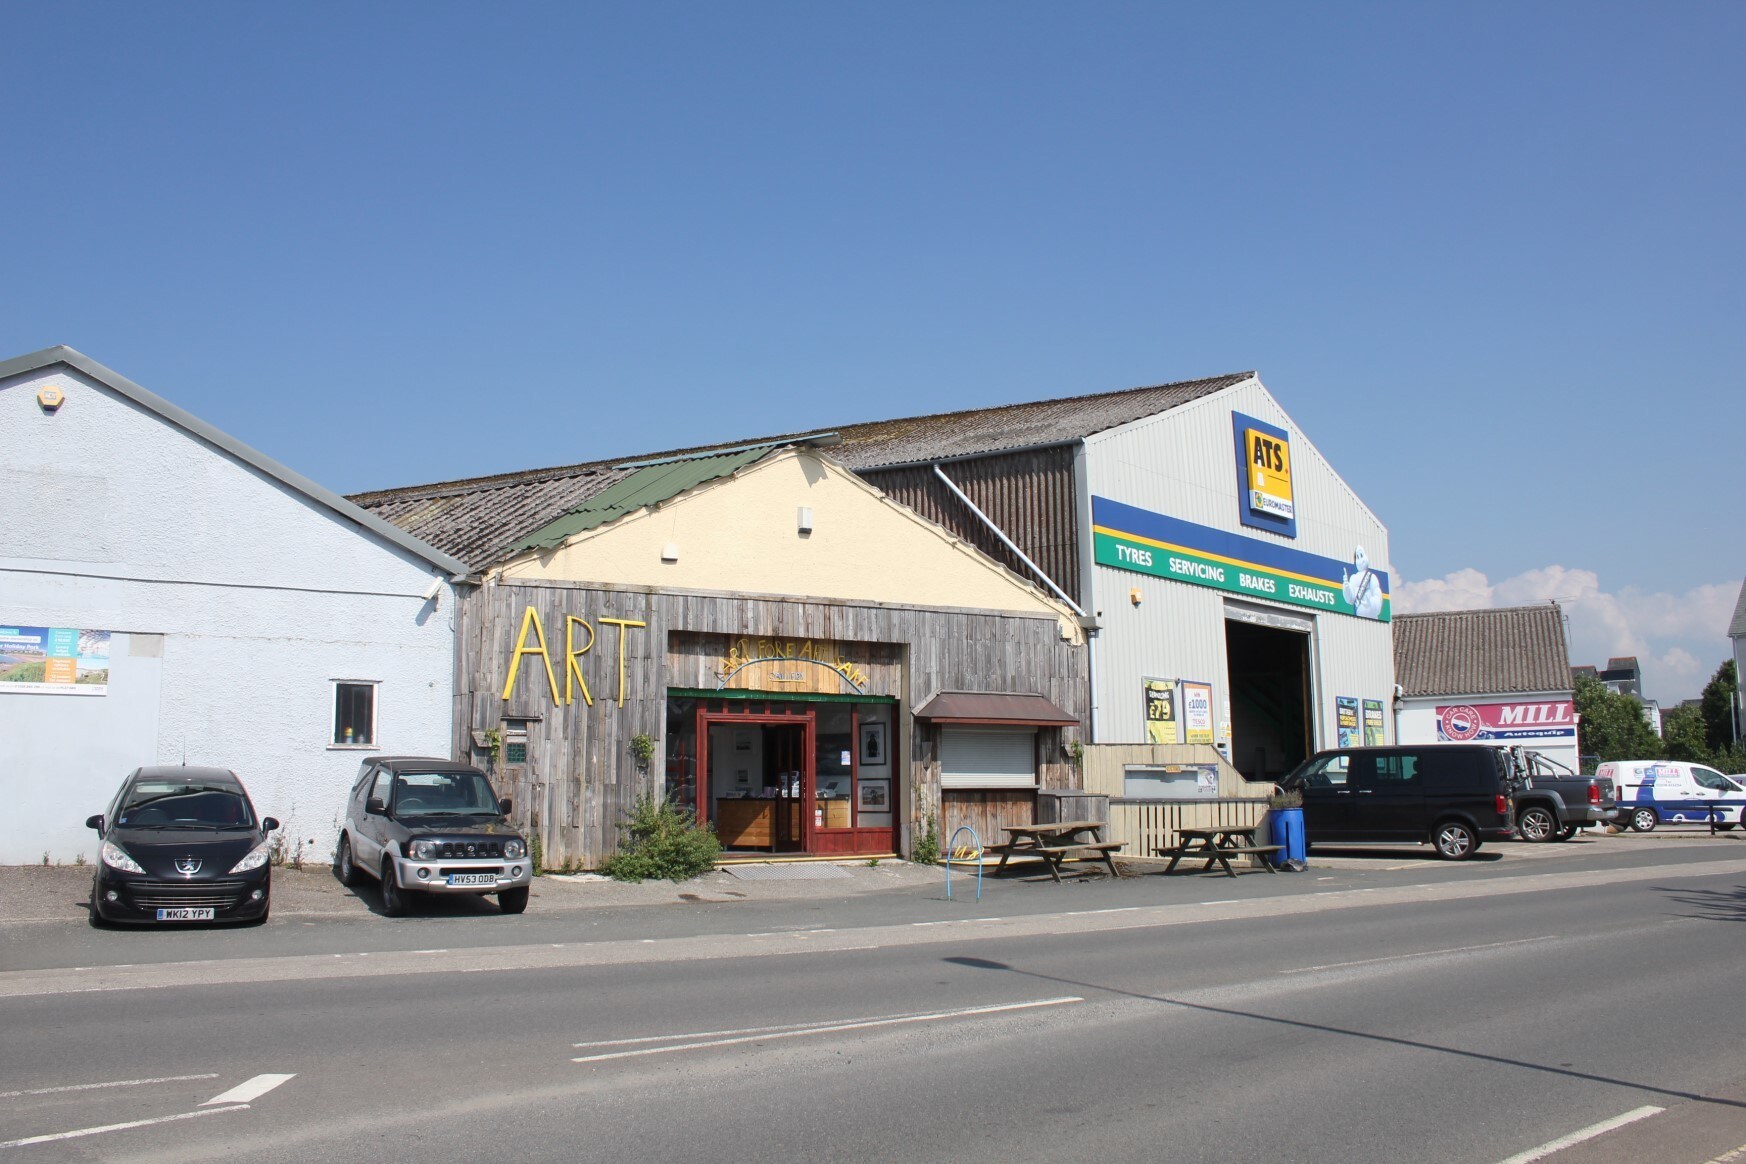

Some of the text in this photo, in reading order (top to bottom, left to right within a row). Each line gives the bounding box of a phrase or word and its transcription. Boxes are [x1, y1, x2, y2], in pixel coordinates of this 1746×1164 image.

[1253, 436, 1283, 473] ATS
[1263, 497, 1293, 514] EUROMASTER
[1115, 544, 1153, 567] TYRES
[1169, 557, 1225, 583] SERVICING
[1239, 573, 1276, 594] BRAKES
[1288, 584, 1335, 606] EXHAUSTS
[4, 643, 26, 651] Holiday
[757, 639, 795, 659] FORE
[502, 606, 646, 709] ART
[1188, 699, 1207, 709] £1000
[1446, 706, 1477, 719] CAR CARE
[1498, 704, 1570, 724] MILL
[1445, 723, 1478, 739] KNOW HOW
[1504, 729, 1565, 738] Autoquip
[454, 875, 477, 884] HV53
[166, 909, 211, 919] WK12 YPY
